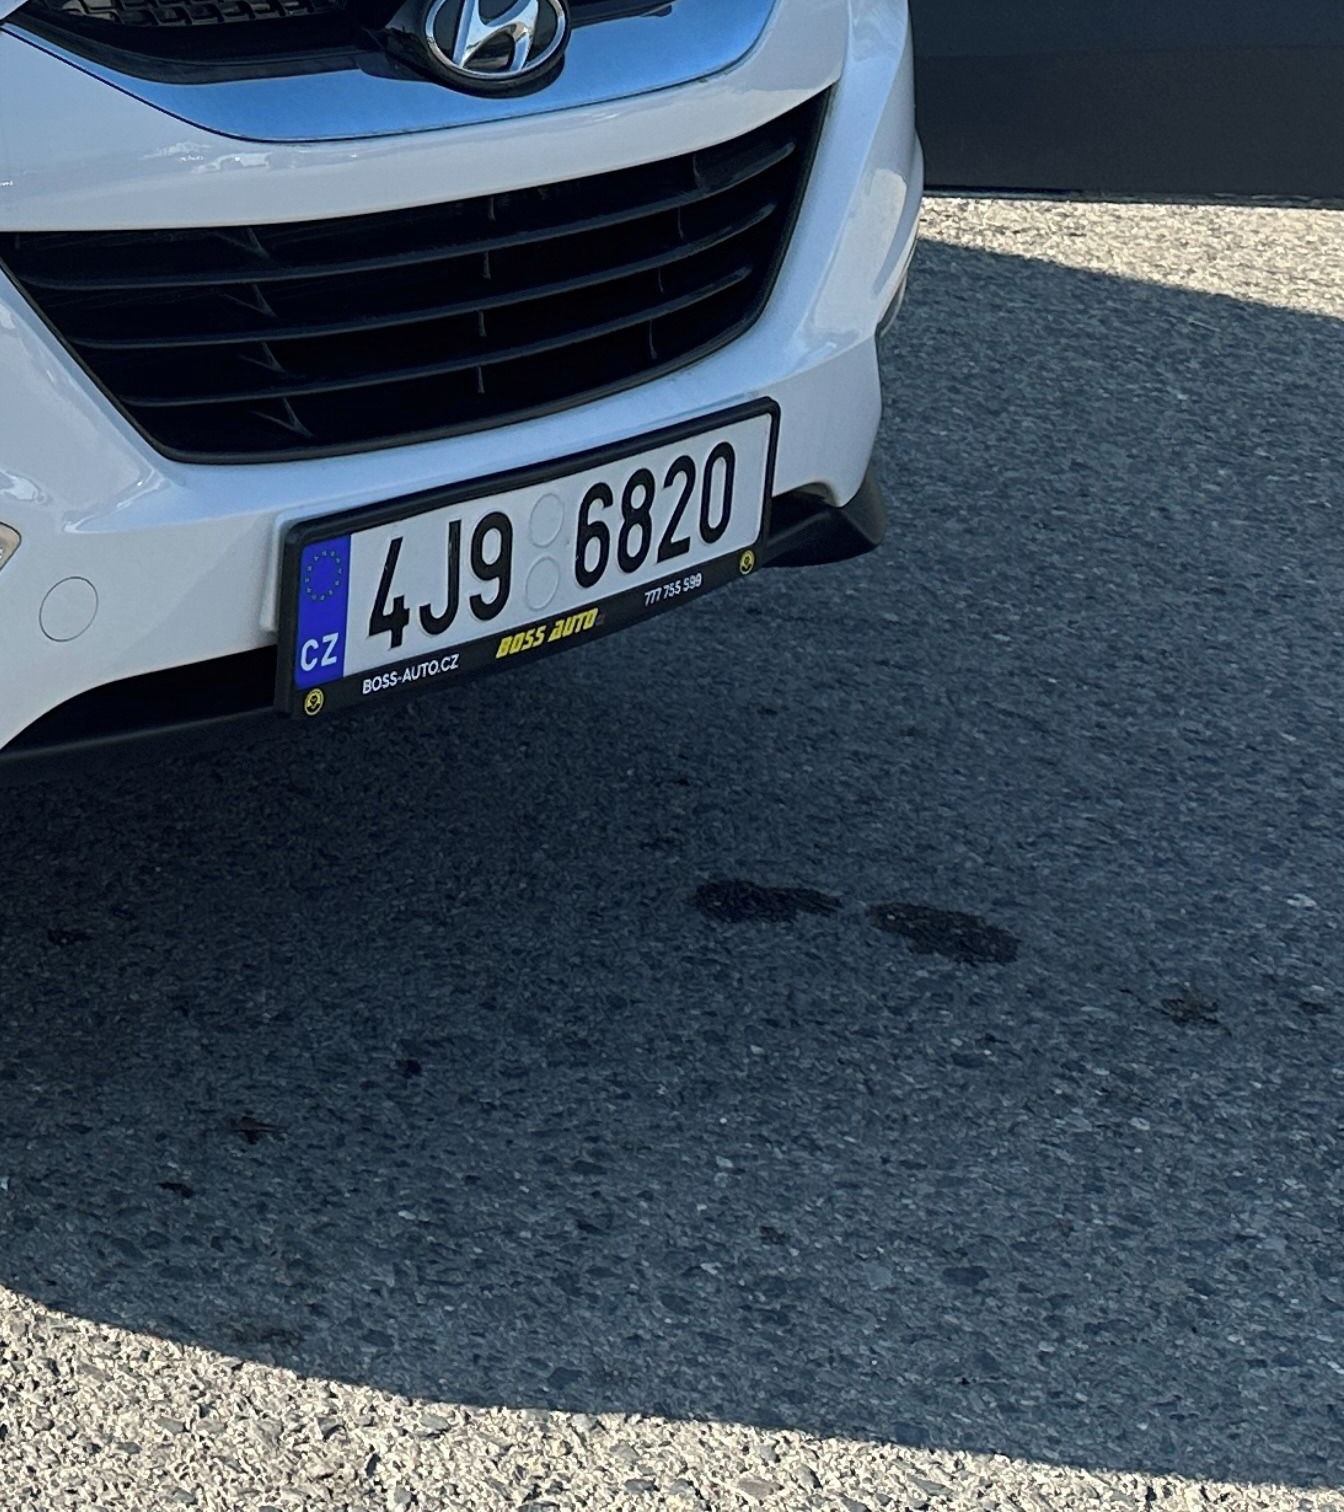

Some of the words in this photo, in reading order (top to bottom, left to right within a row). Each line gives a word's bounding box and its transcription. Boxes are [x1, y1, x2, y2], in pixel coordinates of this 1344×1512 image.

[367, 511, 514, 650] 4J9
[574, 441, 736, 589] 6820
[644, 588, 662, 607] 777
[299, 632, 338, 673] CZ
[495, 625, 547, 660] BOSS
[547, 607, 599, 643] AUTO
[362, 653, 460, 695] BOSS-AUTO.CZ
